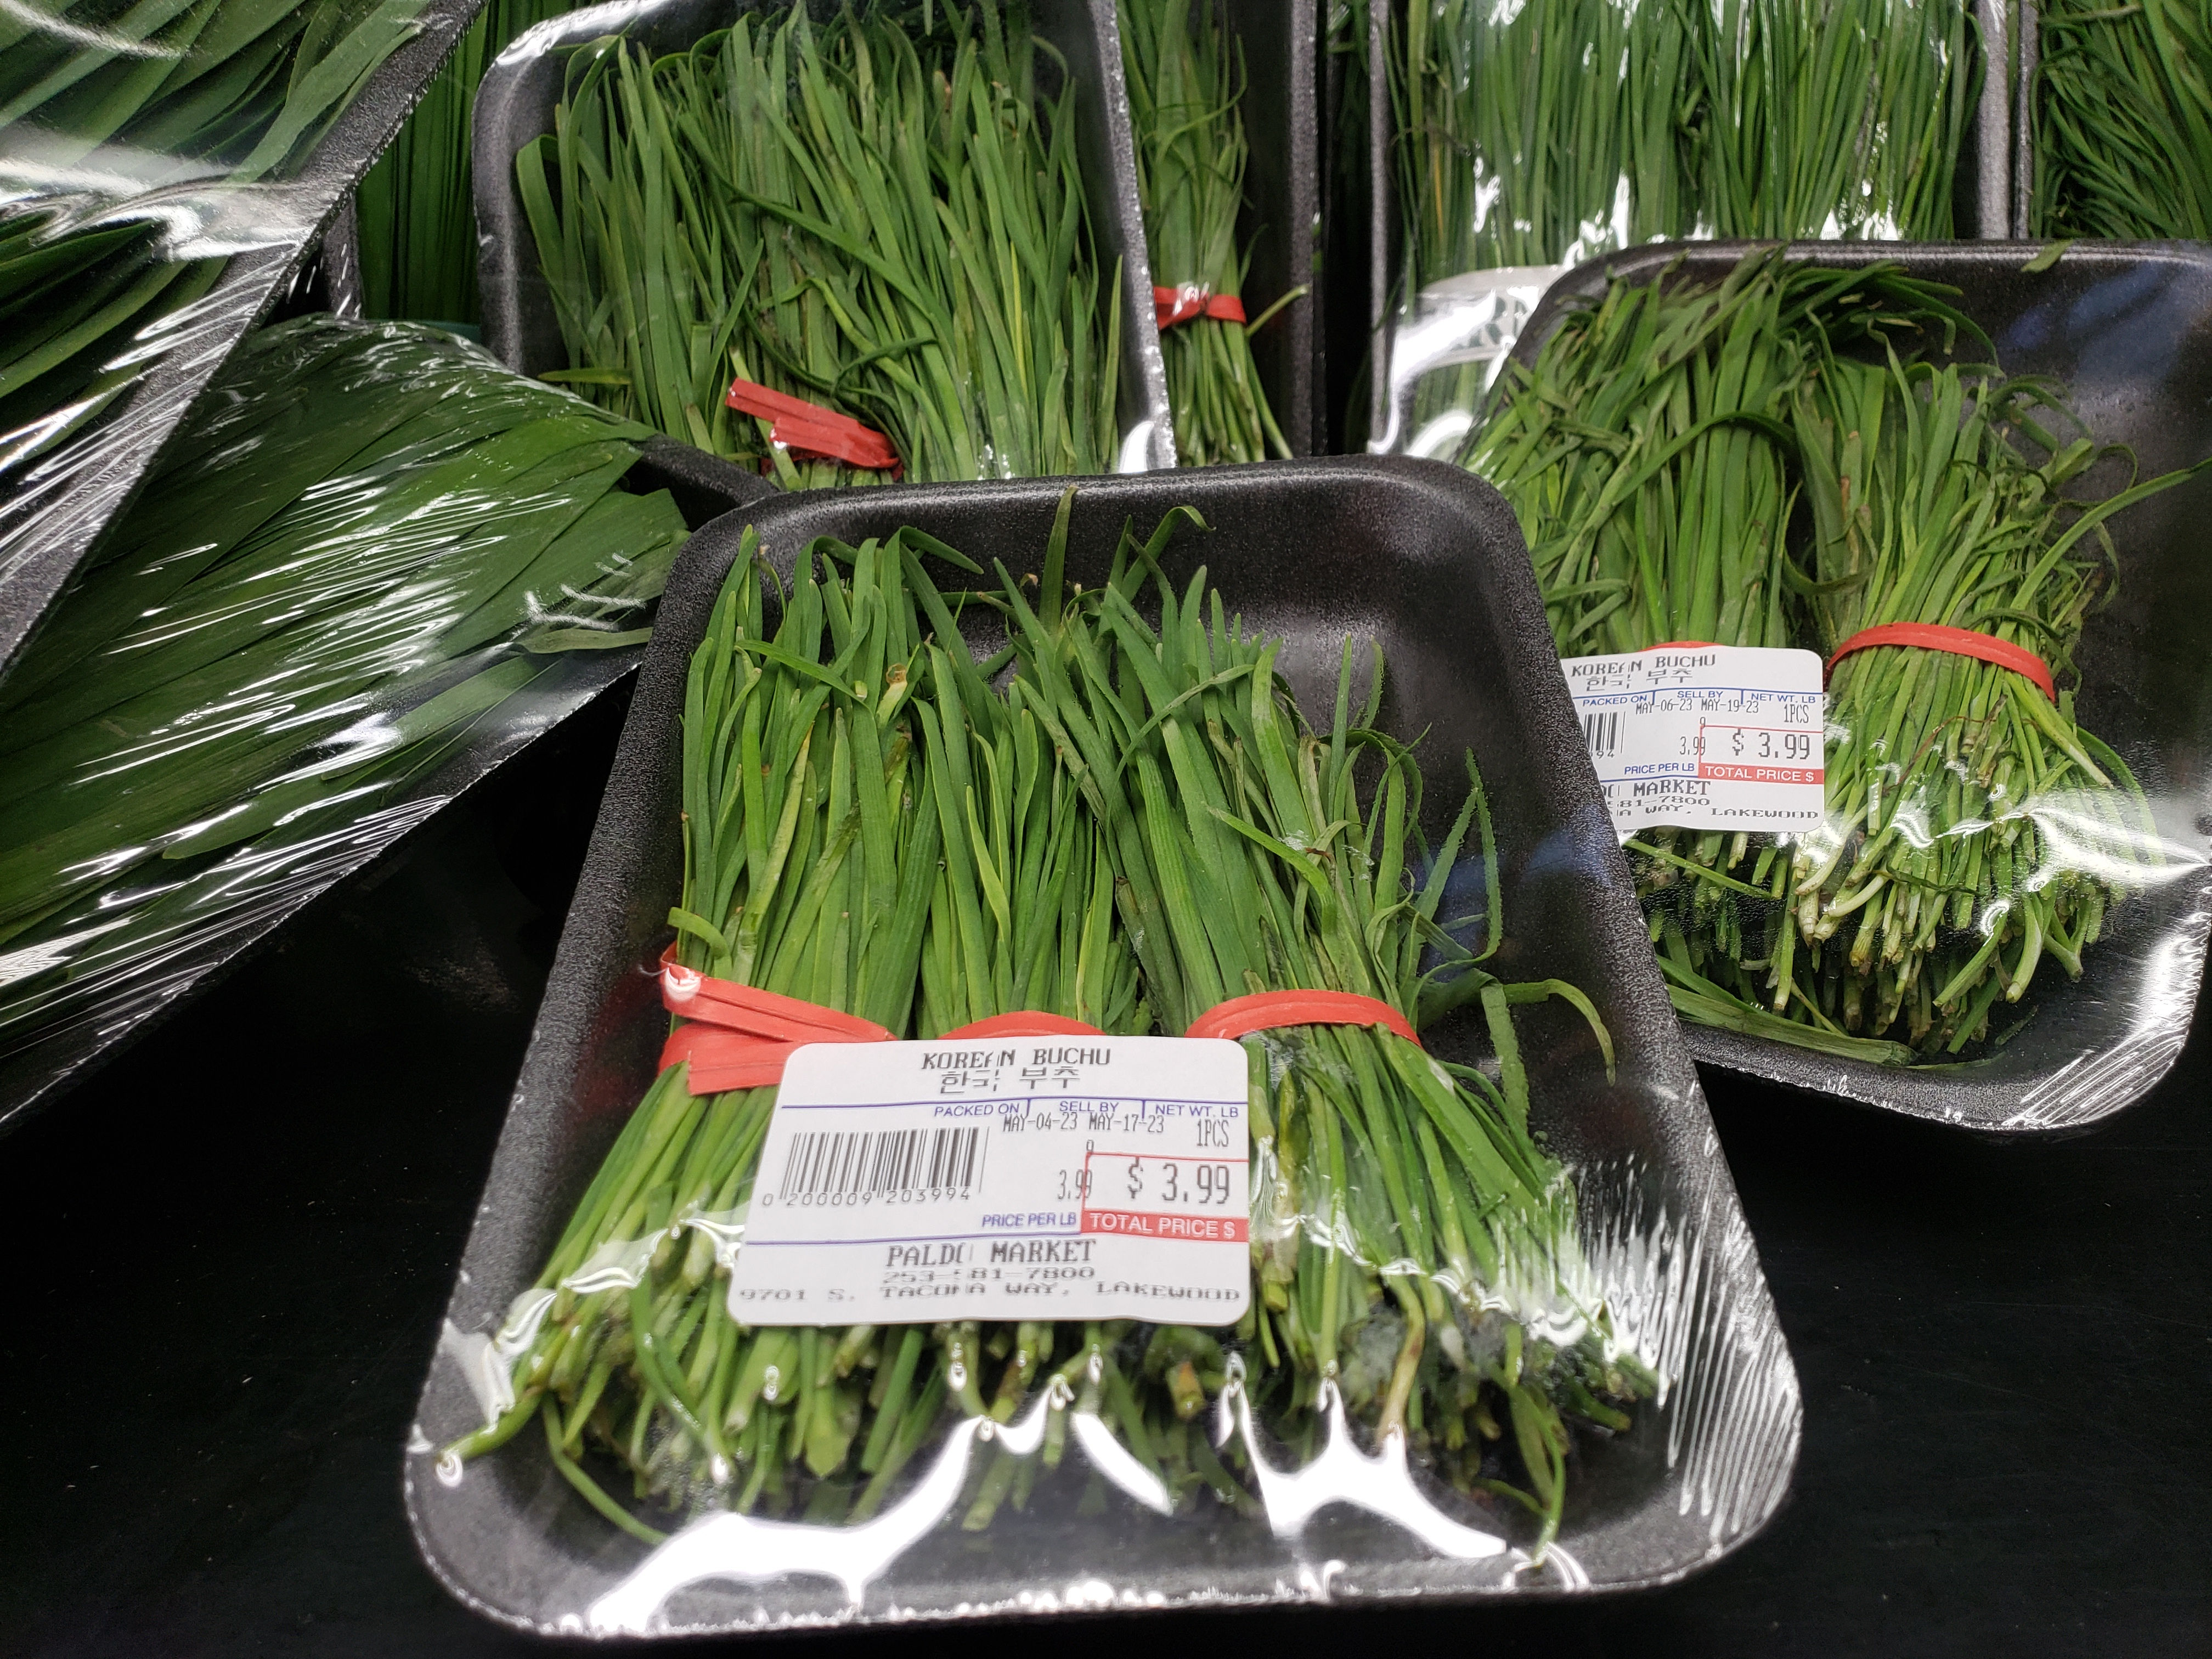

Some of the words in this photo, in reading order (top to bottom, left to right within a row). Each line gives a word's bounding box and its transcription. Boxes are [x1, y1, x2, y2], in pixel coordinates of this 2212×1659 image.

[1656, 654, 1716, 669] BUCHU
[1646, 668, 1693, 685] 부추
[1583, 697, 1628, 707] PACKED
[1636, 698, 1692, 715] MAY-06-23
[1701, 699, 1759, 713] MAY-19-23
[1751, 693, 1774, 701] NET
[1777, 695, 1798, 703] WT.
[1784, 704, 1809, 723] 1PCS
[1679, 736, 1706, 755] 3.99
[1733, 728, 1744, 756] $
[1758, 732, 1810, 759] 3.99
[1624, 764, 1656, 775] PRICE
[1658, 763, 1679, 772] PER
[1682, 763, 1695, 771] LB
[1705, 766, 1752, 778] TOTAL
[1757, 770, 1801, 781] PRICE
[1805, 772, 1814, 782] $
[1633, 780, 1711, 796] MARKET
[1712, 808, 1819, 819] LAKEWOOD
[1032, 1047, 1110, 1065] BUCHU
[1019, 1065, 1080, 1090] 부추
[934, 1104, 993, 1116] PACKED
[998, 1103, 1019, 1114] ON
[1059, 1101, 1095, 1112] SELL
[1100, 1102, 1119, 1113] BY
[1156, 1105, 1185, 1115] NET
[1189, 1105, 1216, 1118] WT.
[1221, 1107, 1238, 1118] LB
[1003, 1112, 1078, 1132] MAY-04-23
[1089, 1112, 1164, 1133] MAY-17-23
[1197, 1119, 1229, 1147] 1PCS
[1057, 1169, 1093, 1200] 3.99
[1127, 1156, 1143, 1199] $
[1162, 1163, 1229, 1204] 3.99
[761, 1193, 774, 1206] 0
[786, 1191, 872, 1207] 200009
[886, 1187, 970, 1204] 203994
[981, 1214, 1024, 1227] PRICE
[1028, 1213, 1056, 1226] PER
[1059, 1212, 1076, 1226] LB
[1090, 1213, 1153, 1234] TOTAL
[1159, 1217, 1218, 1238] PRICE
[990, 1238, 1096, 1263] MARKET
[739, 1289, 807, 1301] 9701
[828, 1289, 855, 1302] S.
[1097, 1280, 1240, 1301] LAKEWOOD
